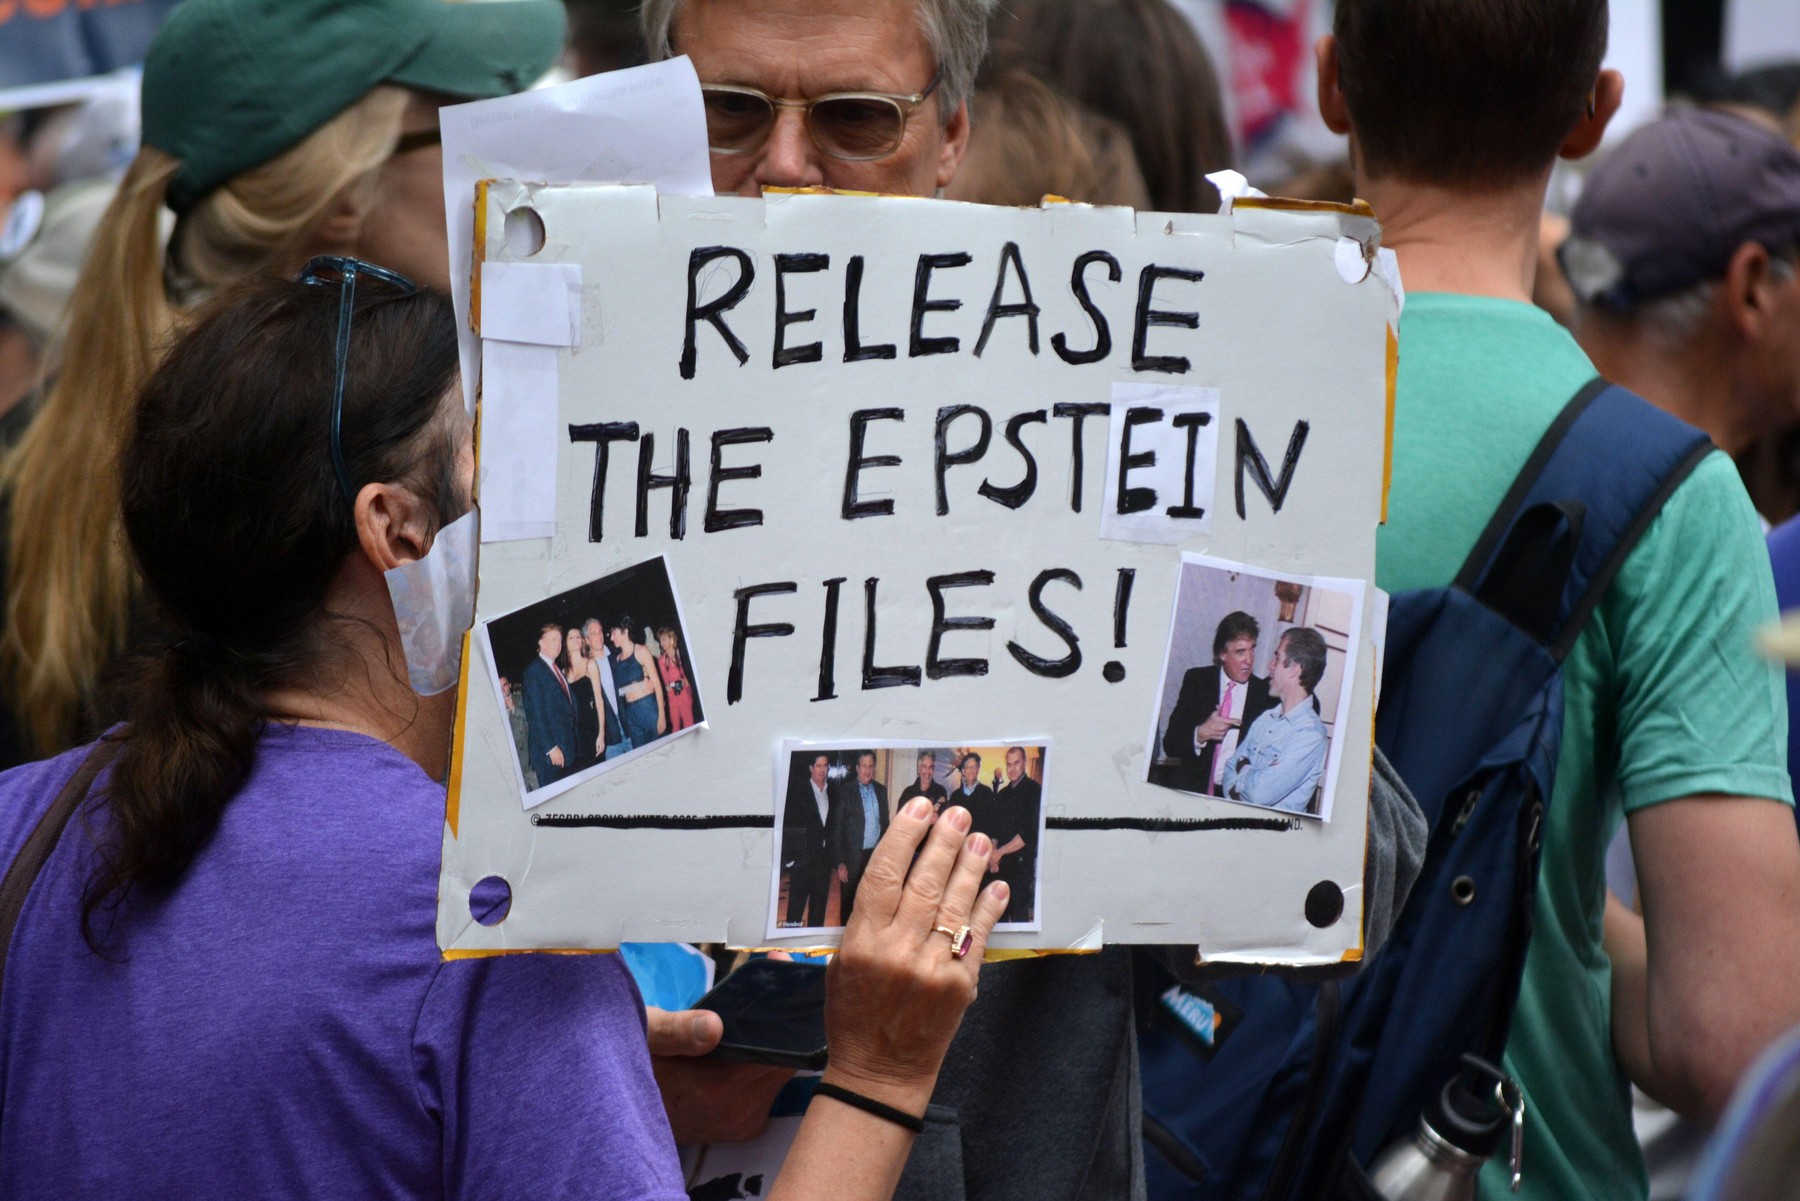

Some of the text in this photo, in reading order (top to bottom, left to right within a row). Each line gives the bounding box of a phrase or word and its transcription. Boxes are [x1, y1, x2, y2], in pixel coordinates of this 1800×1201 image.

[679, 242, 1204, 379] RELEASE
[569, 403, 1309, 542] THE EPSTEIN
[727, 566, 1135, 705] FILES!
